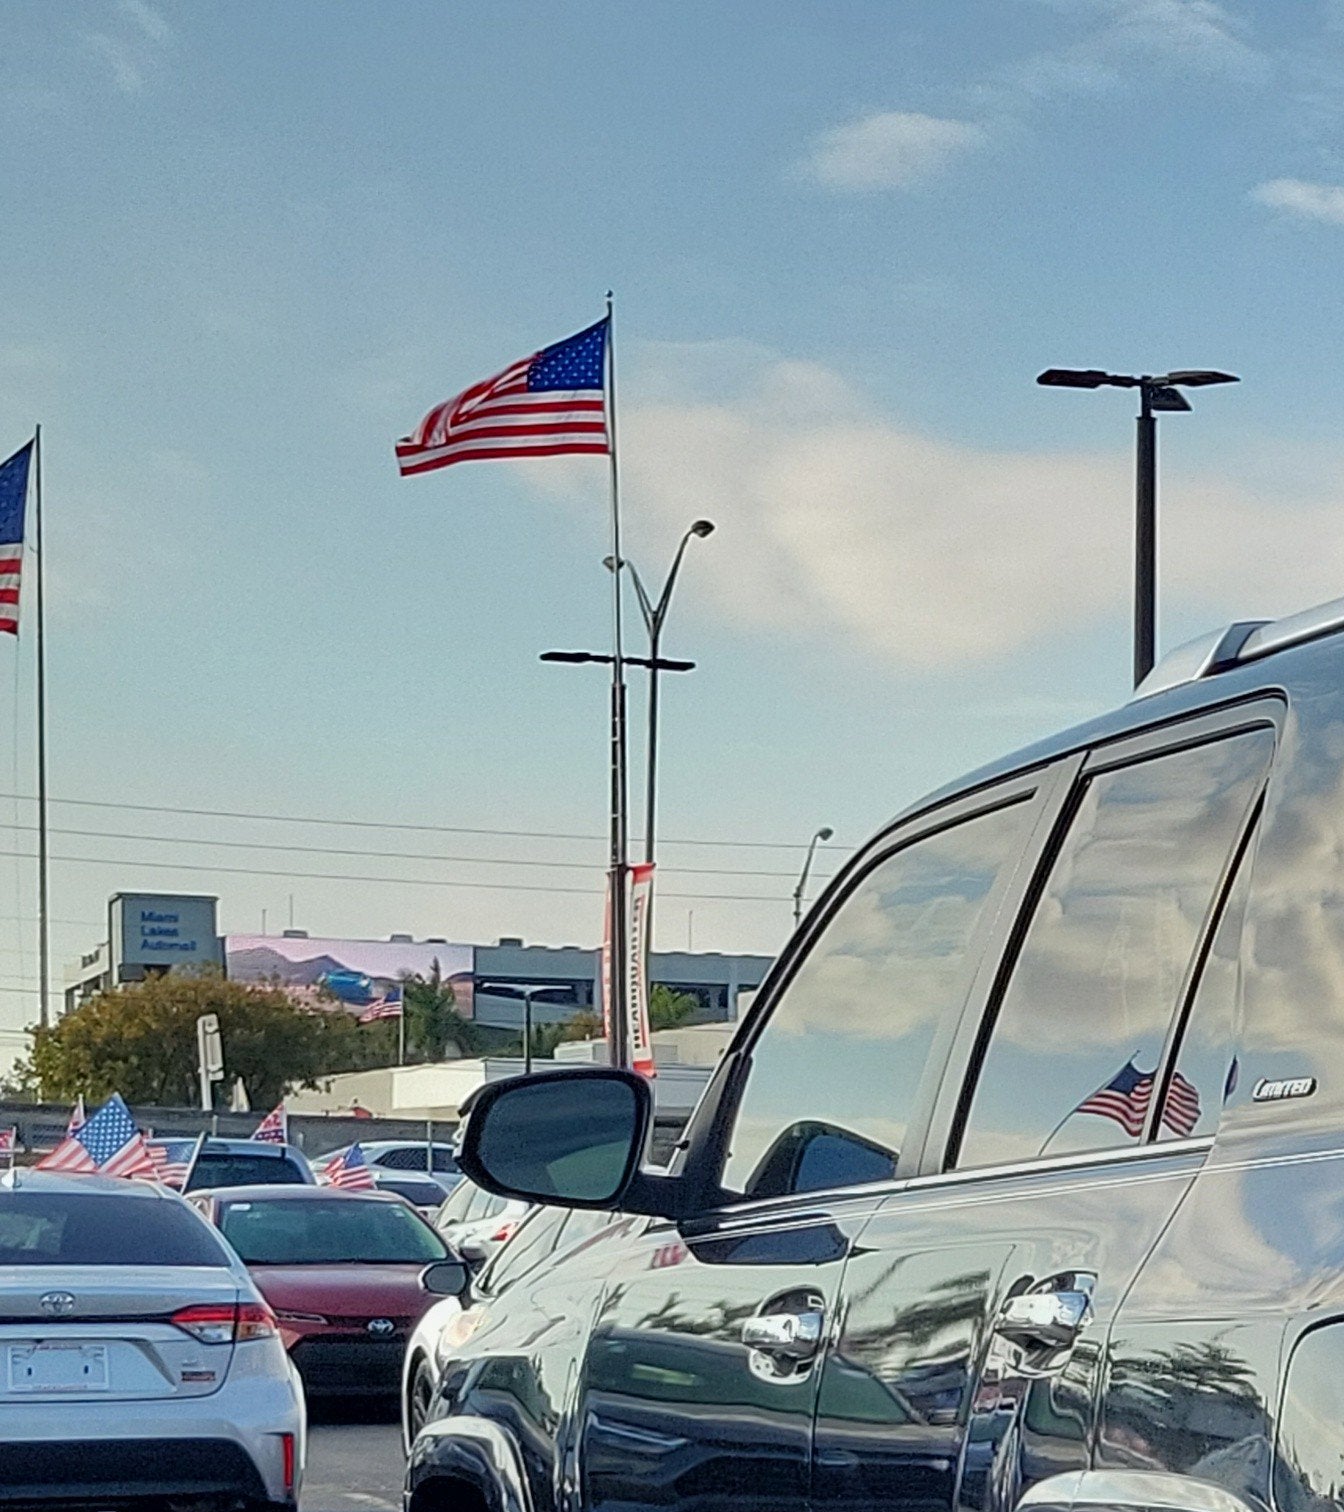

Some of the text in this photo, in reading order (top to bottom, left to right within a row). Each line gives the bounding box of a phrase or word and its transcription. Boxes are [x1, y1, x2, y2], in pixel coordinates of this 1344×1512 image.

[141, 911, 179, 923] Miami
[141, 925, 179, 937] Lakes
[140, 939, 197, 951] Automall
